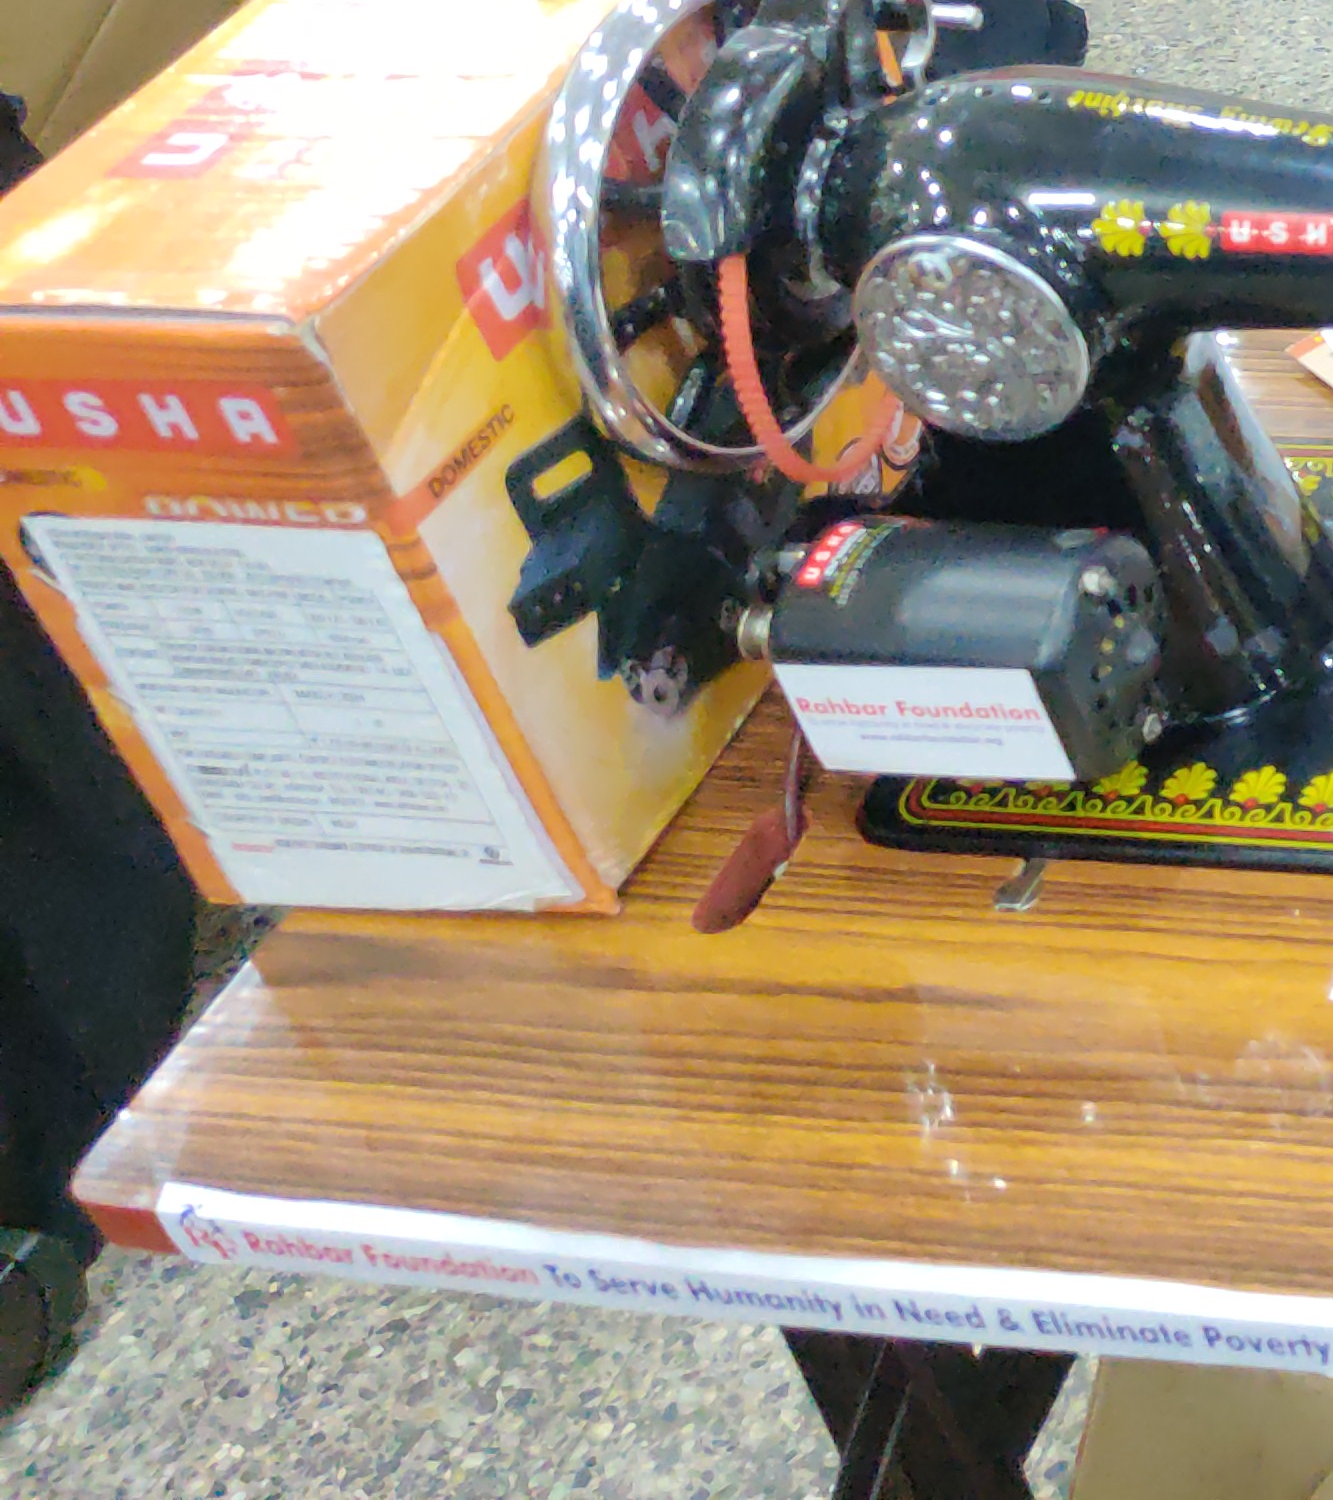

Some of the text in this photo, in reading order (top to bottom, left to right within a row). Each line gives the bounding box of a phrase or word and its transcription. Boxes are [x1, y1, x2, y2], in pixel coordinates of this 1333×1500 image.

[0, 389, 279, 444] USHA
[428, 404, 515, 499] DOMESTIC
[796, 696, 1042, 721] Rahbar Foundation
[242, 1228, 355, 1265] Rahbar
[360, 1242, 540, 1287] Foundation
[541, 1262, 582, 1291] To
[587, 1266, 680, 1302] Serve
[684, 1277, 844, 1323] Humanity
[855, 1288, 885, 1319] in
[894, 1298, 984, 1331] Need
[998, 1308, 1021, 1332] &
[1031, 1309, 1193, 1349] Eliminate
[1201, 1324, 1332, 1367] Poverty
